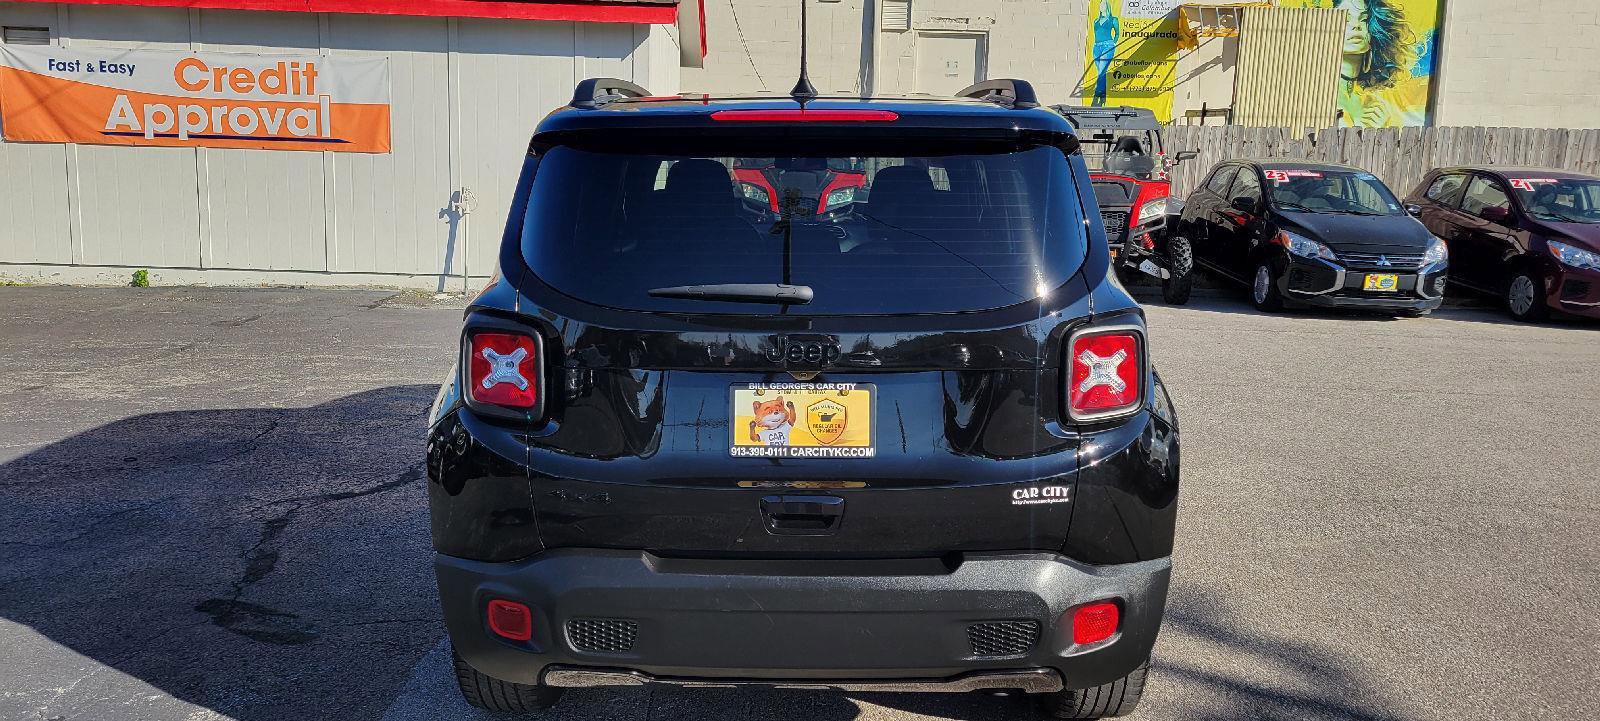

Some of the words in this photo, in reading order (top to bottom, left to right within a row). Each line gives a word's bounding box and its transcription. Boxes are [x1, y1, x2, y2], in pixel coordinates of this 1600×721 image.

[48, 58, 81, 73] Fast
[86, 63, 96, 73] &
[99, 60, 136, 77] Easy
[173, 57, 319, 96] Credit
[104, 94, 332, 141] Approval
[1265, 170, 1287, 181] 23
[1511, 179, 1532, 191] 21
[765, 335, 842, 369] Jeep
[748, 383, 770, 391] BILL
[771, 383, 815, 391] GEORGE'S
[816, 383, 836, 391] CAR
[837, 383, 857, 391] CITY
[768, 431, 786, 442] CAR
[731, 447, 788, 457] 913-390-0111
[790, 447, 875, 457] CARCITYKC.COM
[1012, 487, 1039, 499] CAR
[1042, 486, 1069, 497] CITY
